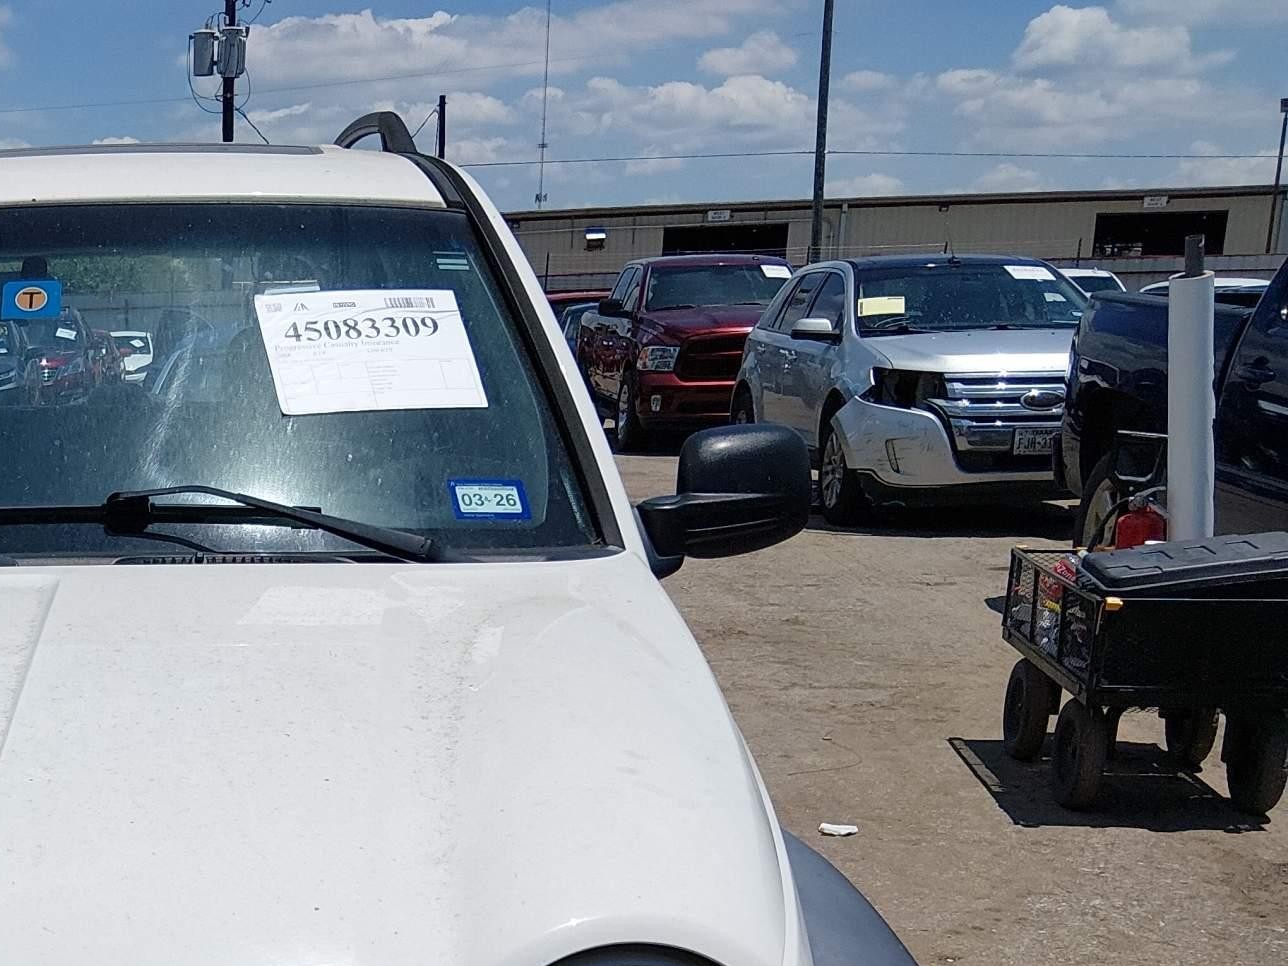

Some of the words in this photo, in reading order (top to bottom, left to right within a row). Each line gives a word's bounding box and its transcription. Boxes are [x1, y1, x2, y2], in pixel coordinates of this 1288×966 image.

[22, 291, 42, 309] T
[284, 316, 439, 342] 45083309
[461, 493, 485, 507] 03
[493, 493, 517, 507] 26
